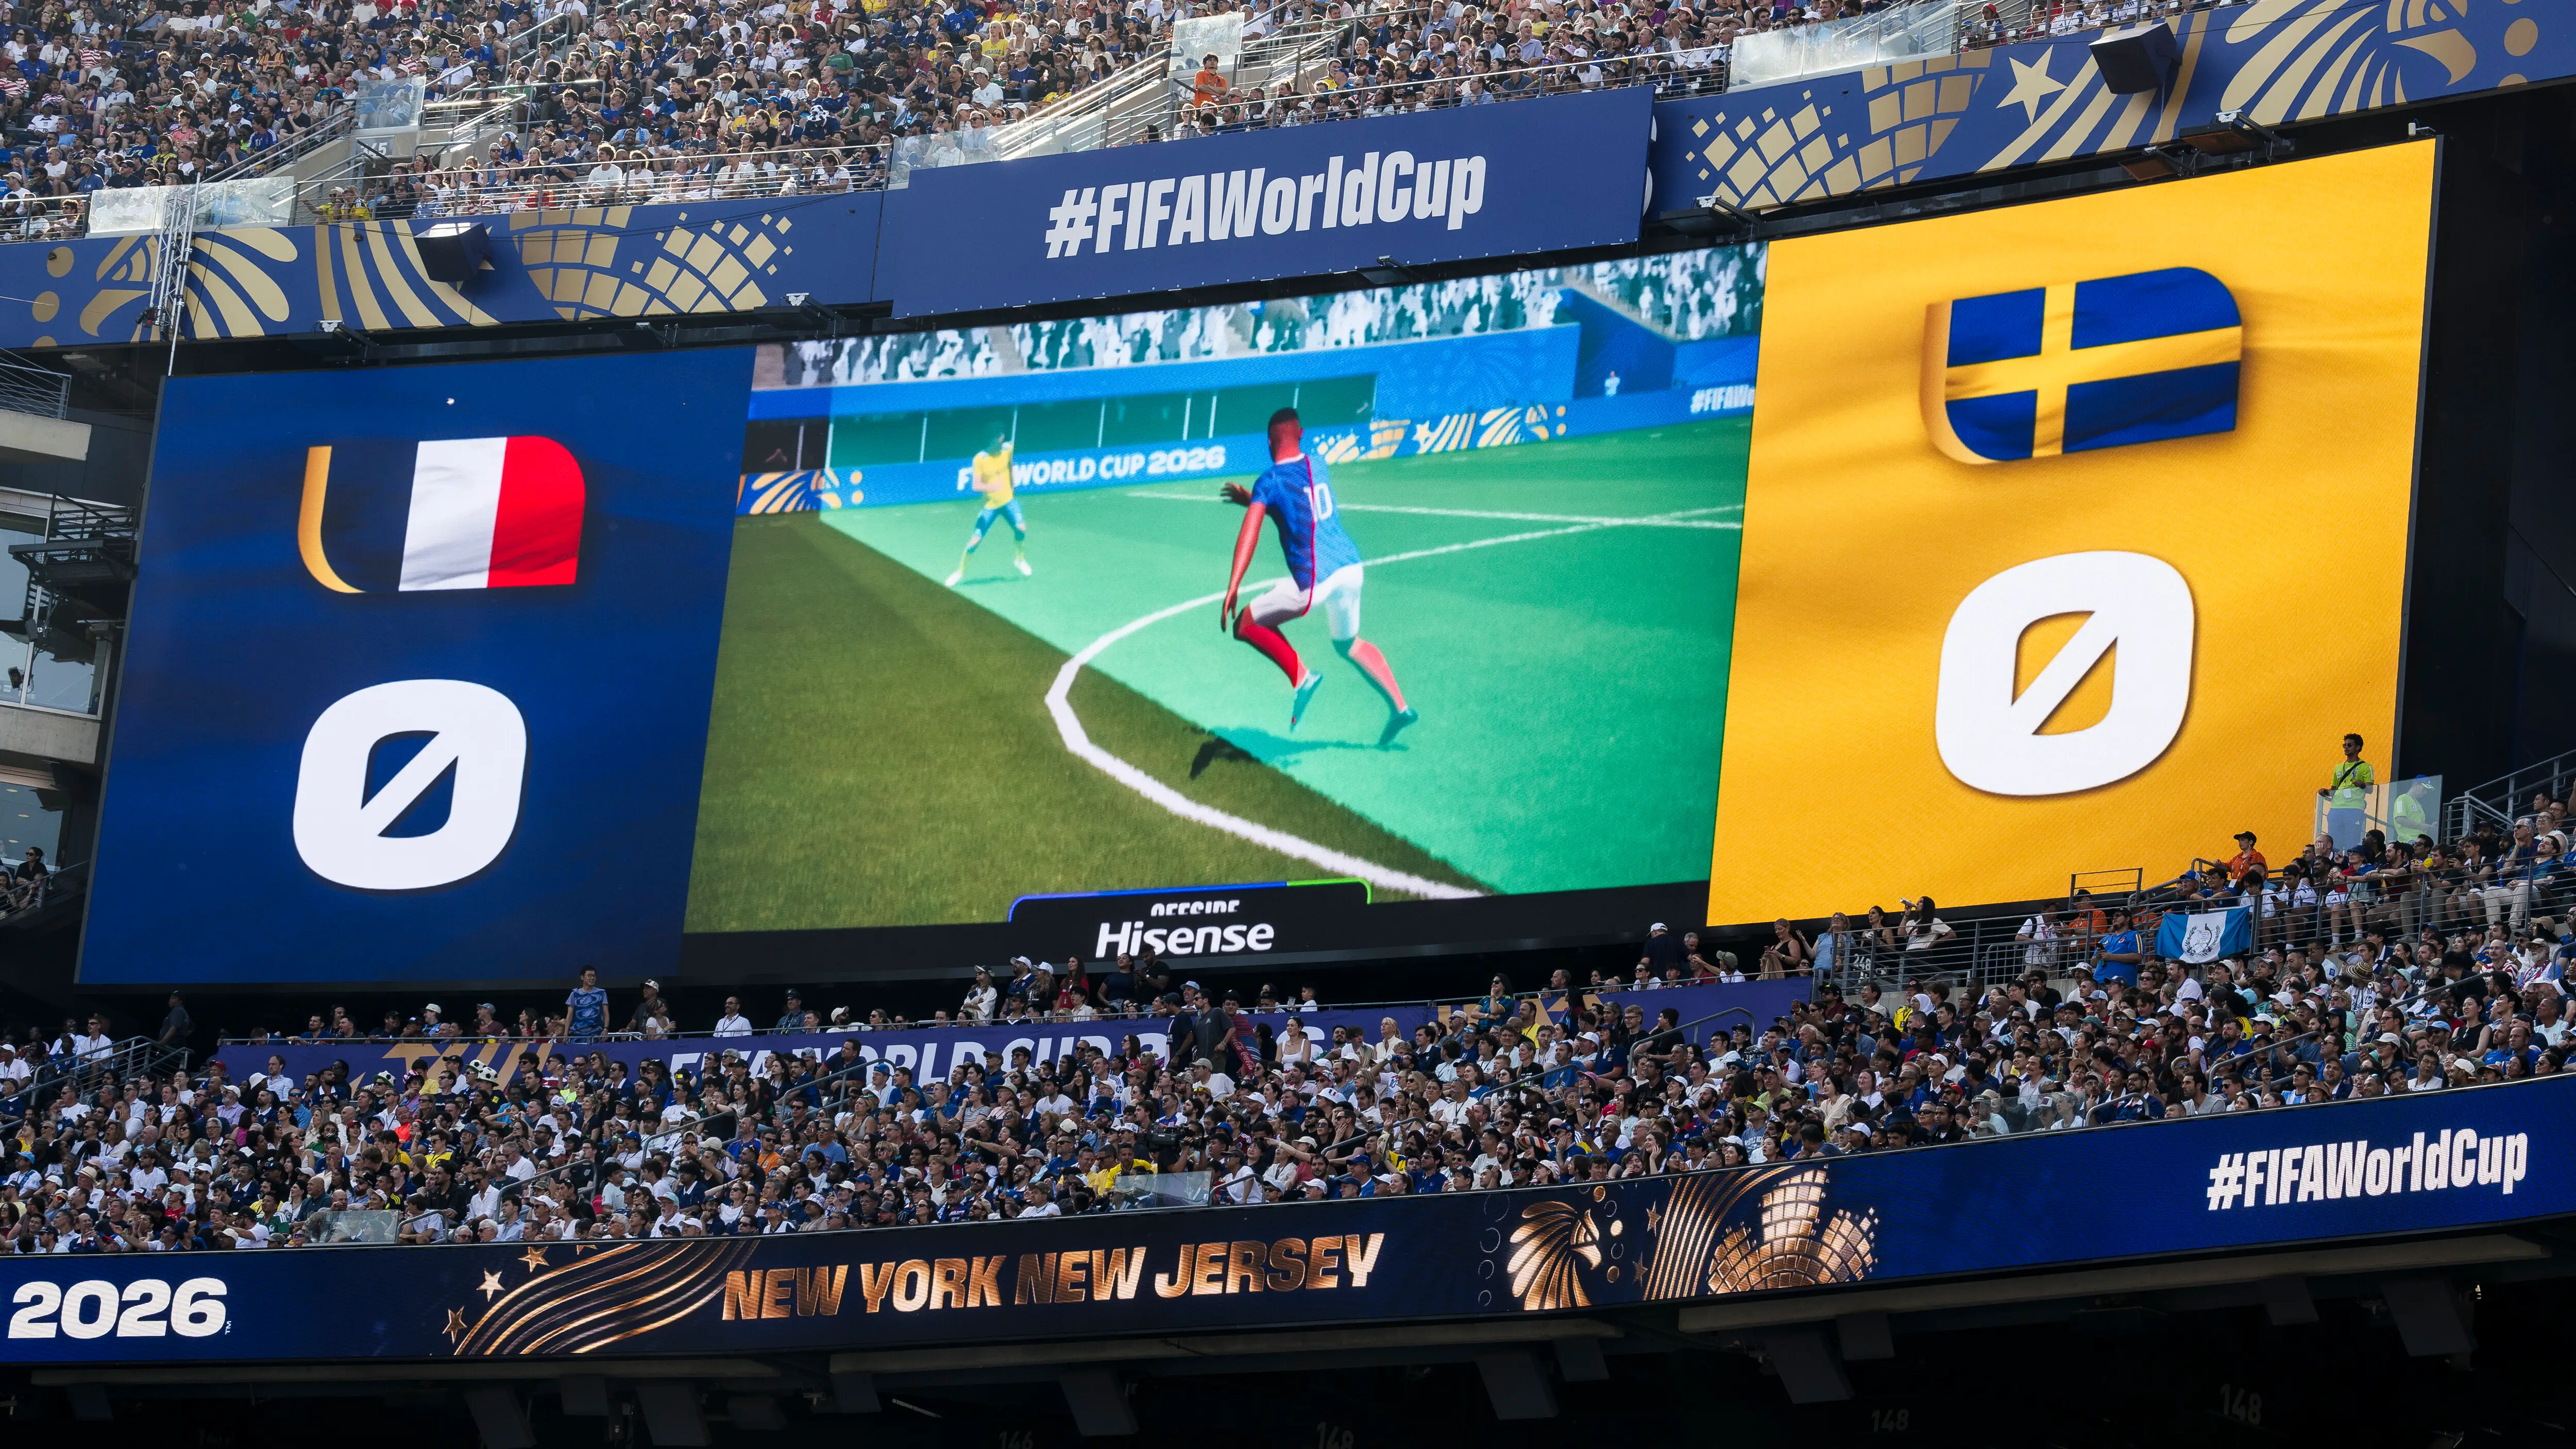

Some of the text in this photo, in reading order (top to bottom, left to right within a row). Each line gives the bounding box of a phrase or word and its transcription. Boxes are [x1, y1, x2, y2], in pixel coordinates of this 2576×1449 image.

[1045, 150, 1486, 259] #FIFAWorldCup
[1012, 446, 1226, 487] WORLD CUP 2026
[1303, 483, 1332, 523] 10
[1936, 551, 2195, 796] 0
[293, 679, 527, 890] 0
[1095, 922, 1274, 958] Hisense
[1853, 953, 1871, 971] 248
[2207, 1128, 2528, 1211] #FIFAWorldCup
[722, 1233, 1385, 1320] NEW YORK NEW JERSEY
[8, 1277, 227, 1339] 2026
[1871, 1408, 1909, 1434] 148
[2220, 1383, 2262, 1426] 148
